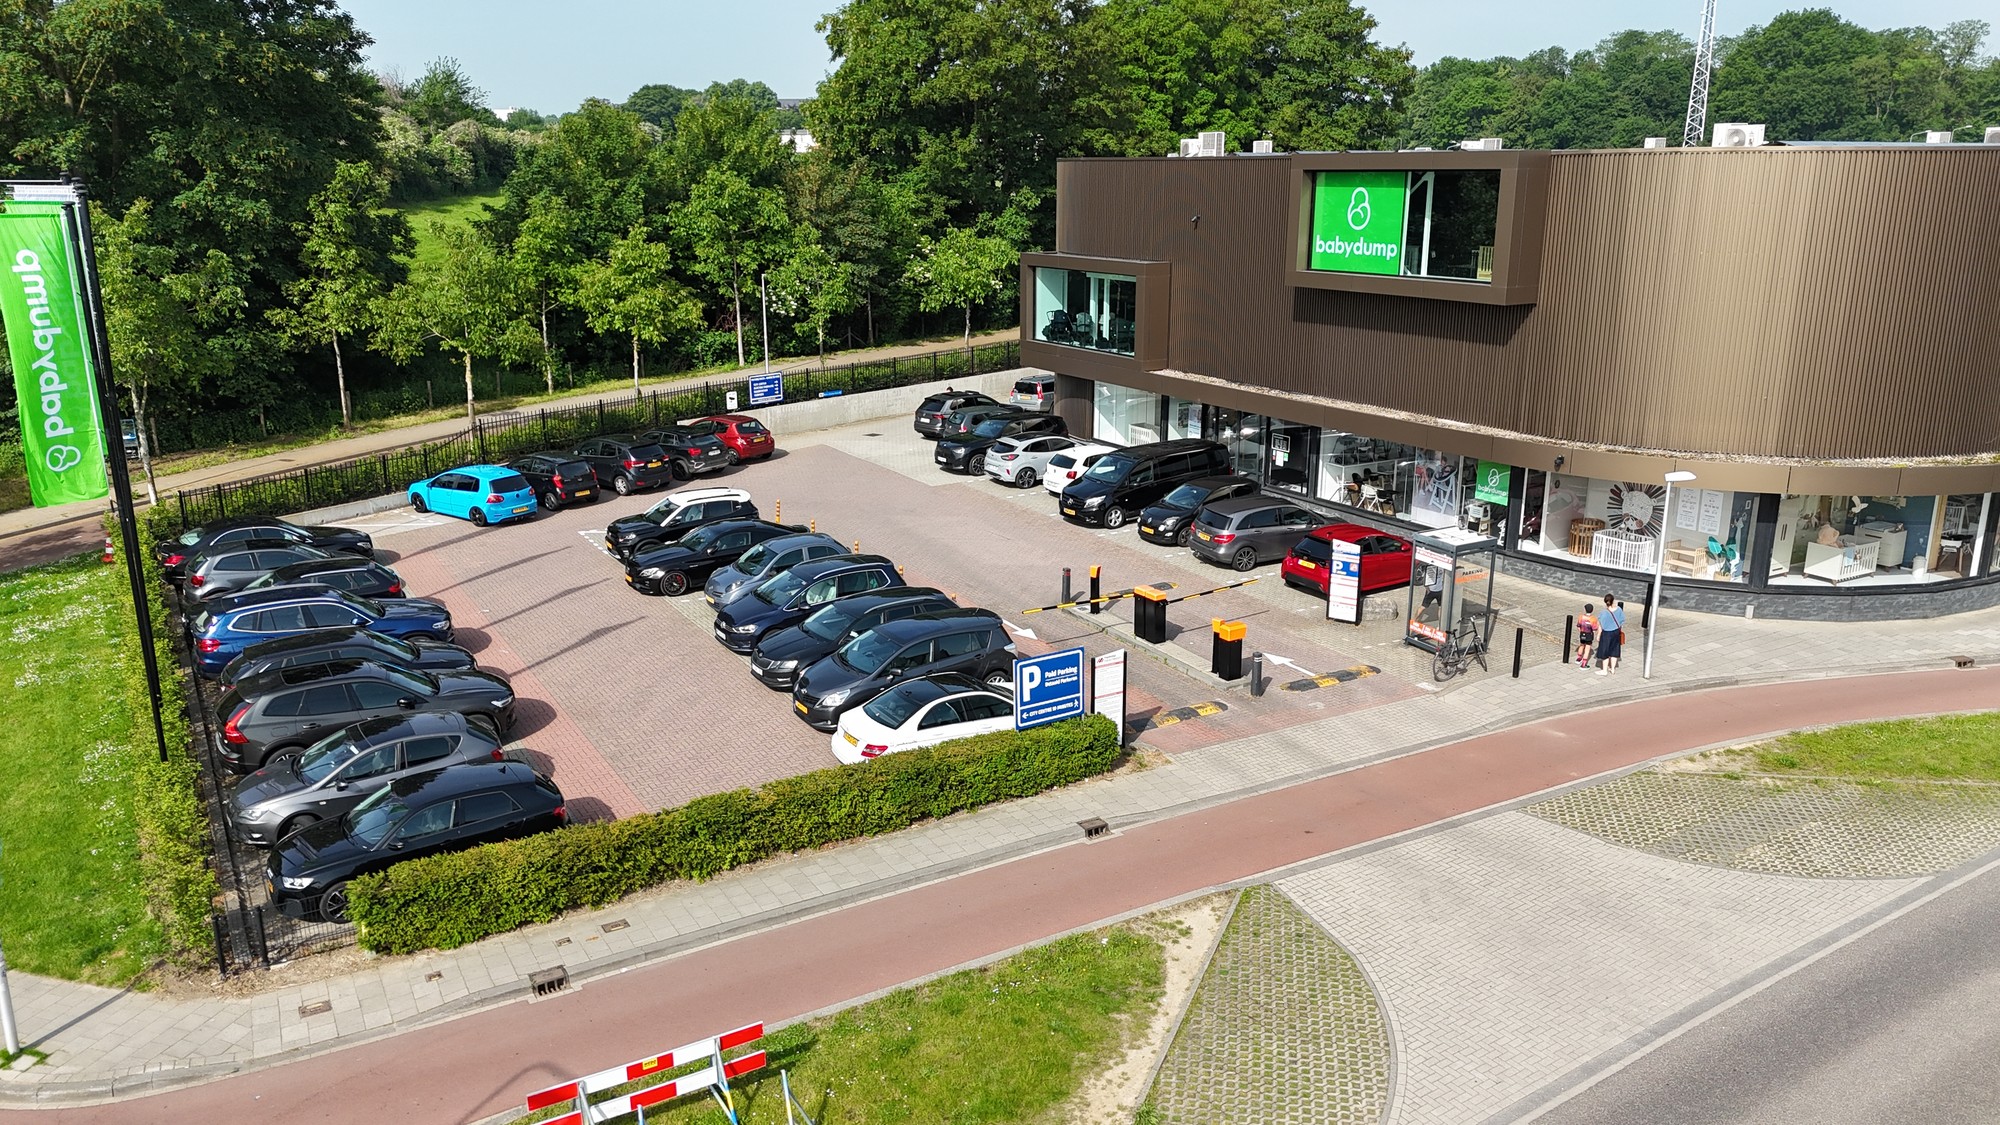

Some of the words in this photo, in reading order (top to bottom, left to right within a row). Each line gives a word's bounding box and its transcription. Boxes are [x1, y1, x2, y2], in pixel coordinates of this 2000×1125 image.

[1315, 234, 1398, 261] babydump
[1478, 484, 1507, 497] babydump
[1333, 560, 1344, 574] P
[1462, 568, 1483, 576] PARKING
[1045, 669, 1057, 678] Paid
[1057, 666, 1078, 676] Parking
[1022, 665, 1042, 702] P
